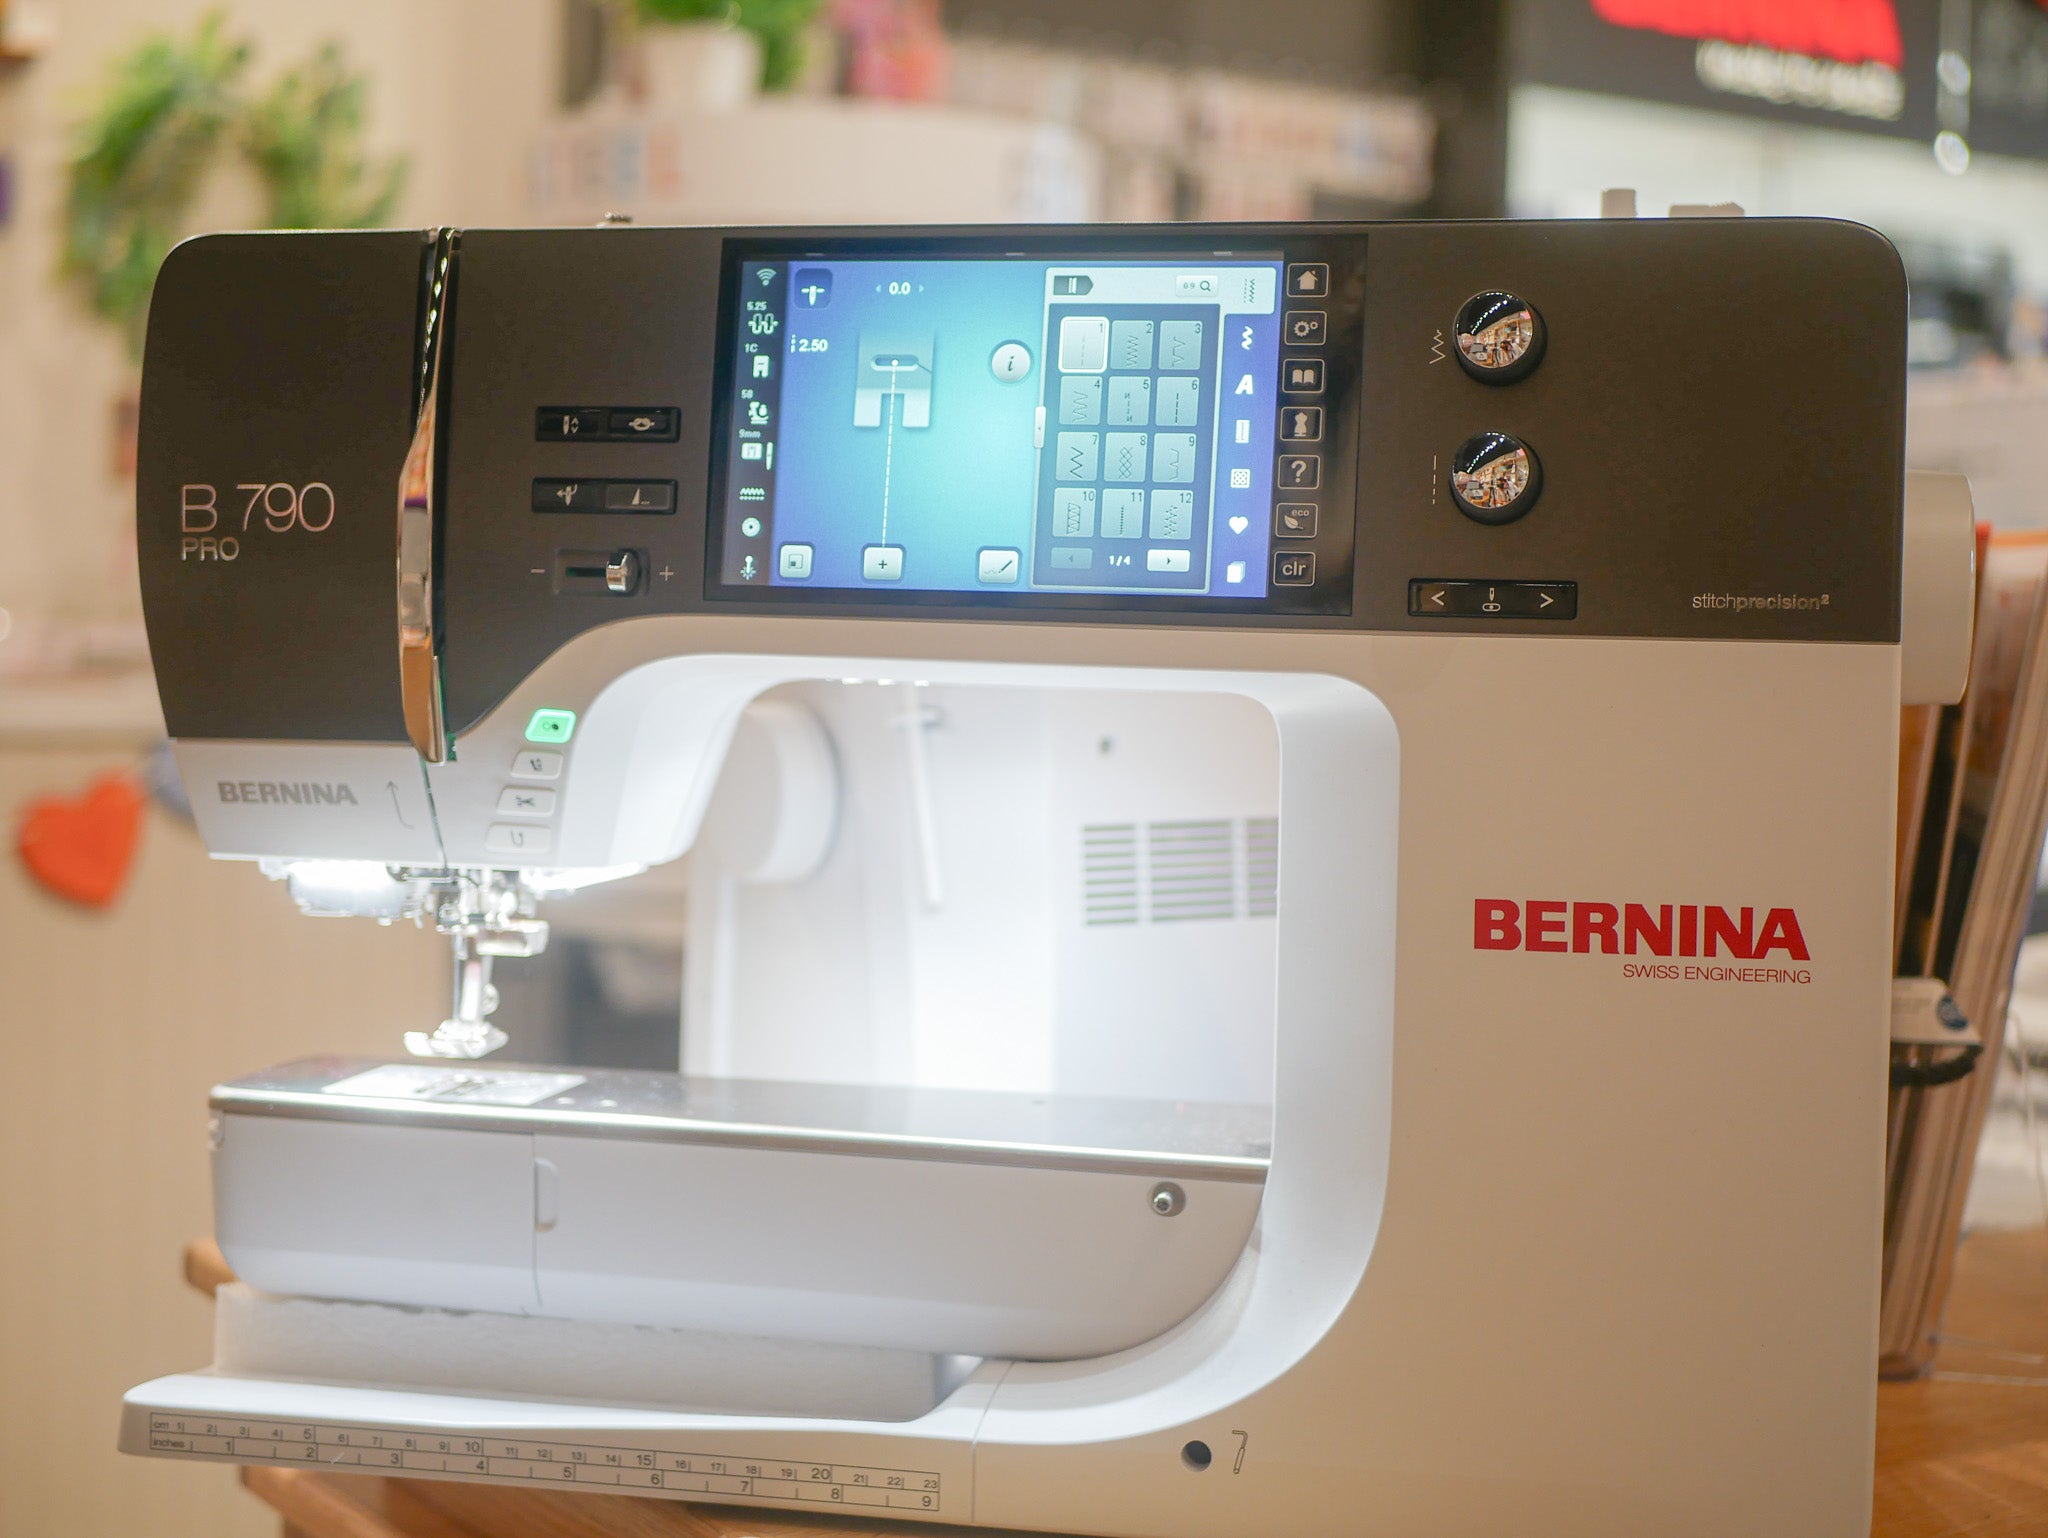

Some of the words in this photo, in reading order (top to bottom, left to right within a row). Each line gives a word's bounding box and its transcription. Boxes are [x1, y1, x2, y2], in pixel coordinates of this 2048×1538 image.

[889, 281, 911, 295] 0.0
[746, 301, 767, 311] 5.25
[1146, 323, 1153, 334] 2
[1194, 323, 1201, 334] 3
[744, 343, 758, 353] 1C
[798, 338, 829, 352] 2.50
[1094, 380, 1101, 390] 4
[1143, 379, 1150, 390] 5
[1192, 380, 1198, 390] 6
[1091, 435, 1098, 445] 7
[1140, 436, 1146, 446] 8
[1188, 436, 1195, 446] 9
[1082, 491, 1095, 501] 10
[1131, 492, 1142, 502] 11
[1180, 493, 1192, 503] 12
[182, 484, 217, 533] B
[236, 482, 335, 532] 790
[1291, 509, 1310, 517] eco
[181, 537, 240, 561] PRO
[1109, 555, 1131, 566] 1/4
[1282, 561, 1307, 577] clr
[217, 781, 358, 805] BERNINA
[1474, 898, 1811, 961] BERNINA
[1623, 963, 1680, 980] SWISS
[1685, 966, 1811, 984] ENGINEERING
[272, 1429, 279, 1437] 4
[303, 1428, 313, 1440] 5
[338, 1434, 345, 1443] 6
[405, 1439, 412, 1448] 8
[439, 1441, 446, 1450] 9
[464, 1441, 481, 1453] 10
[505, 1446, 515, 1456] 11
[537, 1449, 548, 1458] 12
[571, 1451, 583, 1460] 13
[605, 1454, 617, 1463] 14
[637, 1454, 652, 1466] 15
[675, 1460, 687, 1469] 16
[711, 1462, 722, 1472] 17
[745, 1465, 757, 1475] 18
[781, 1468, 793, 1478] 19
[811, 1468, 831, 1480] 20
[853, 1473, 865, 1483] 21
[887, 1476, 901, 1486] 22
[923, 1479, 938, 1489] 23
[153, 1438, 185, 1448] inches
[306, 1447, 315, 1458] 2
[391, 1453, 399, 1464] 3
[476, 1460, 485, 1471] 4
[563, 1467, 573, 1479] 5
[651, 1474, 661, 1485] 6
[740, 1481, 750, 1493] 7
[831, 1488, 840, 1500] 8
[922, 1496, 932, 1507] 9
